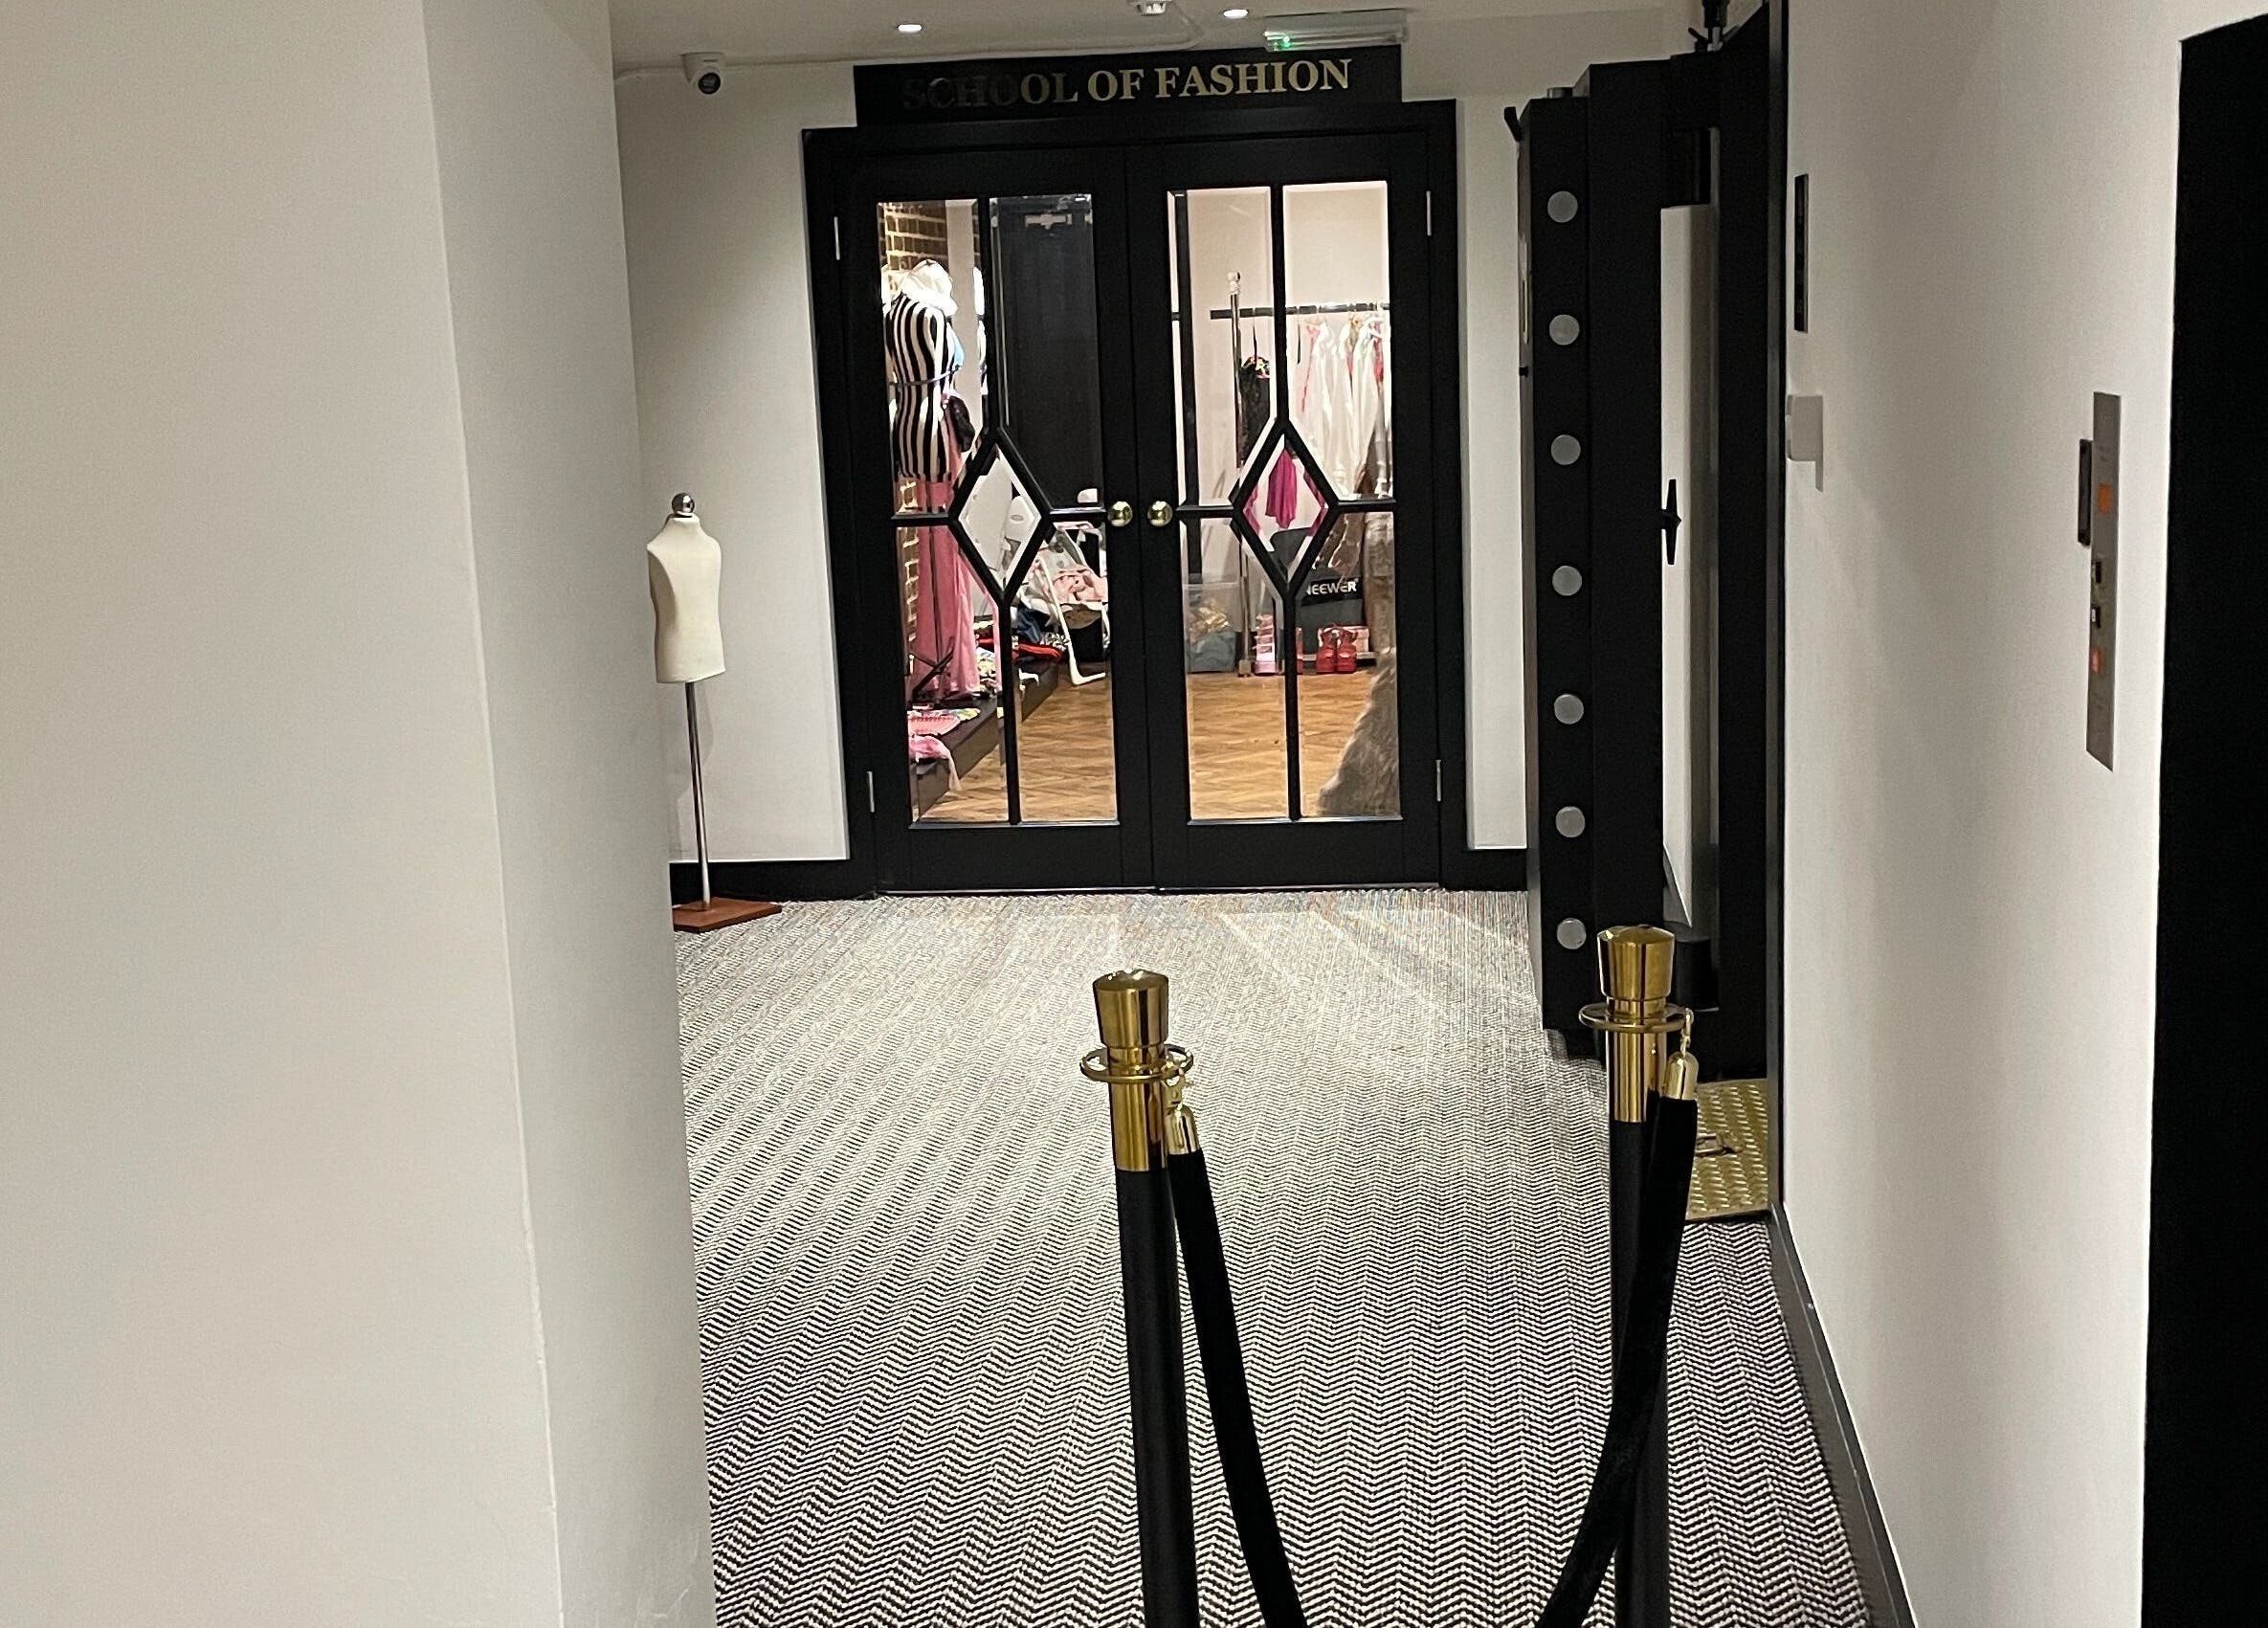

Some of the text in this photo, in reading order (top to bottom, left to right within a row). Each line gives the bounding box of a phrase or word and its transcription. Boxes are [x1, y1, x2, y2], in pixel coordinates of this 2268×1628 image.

[902, 58, 1353, 110] SCHOOL OF FASHION
